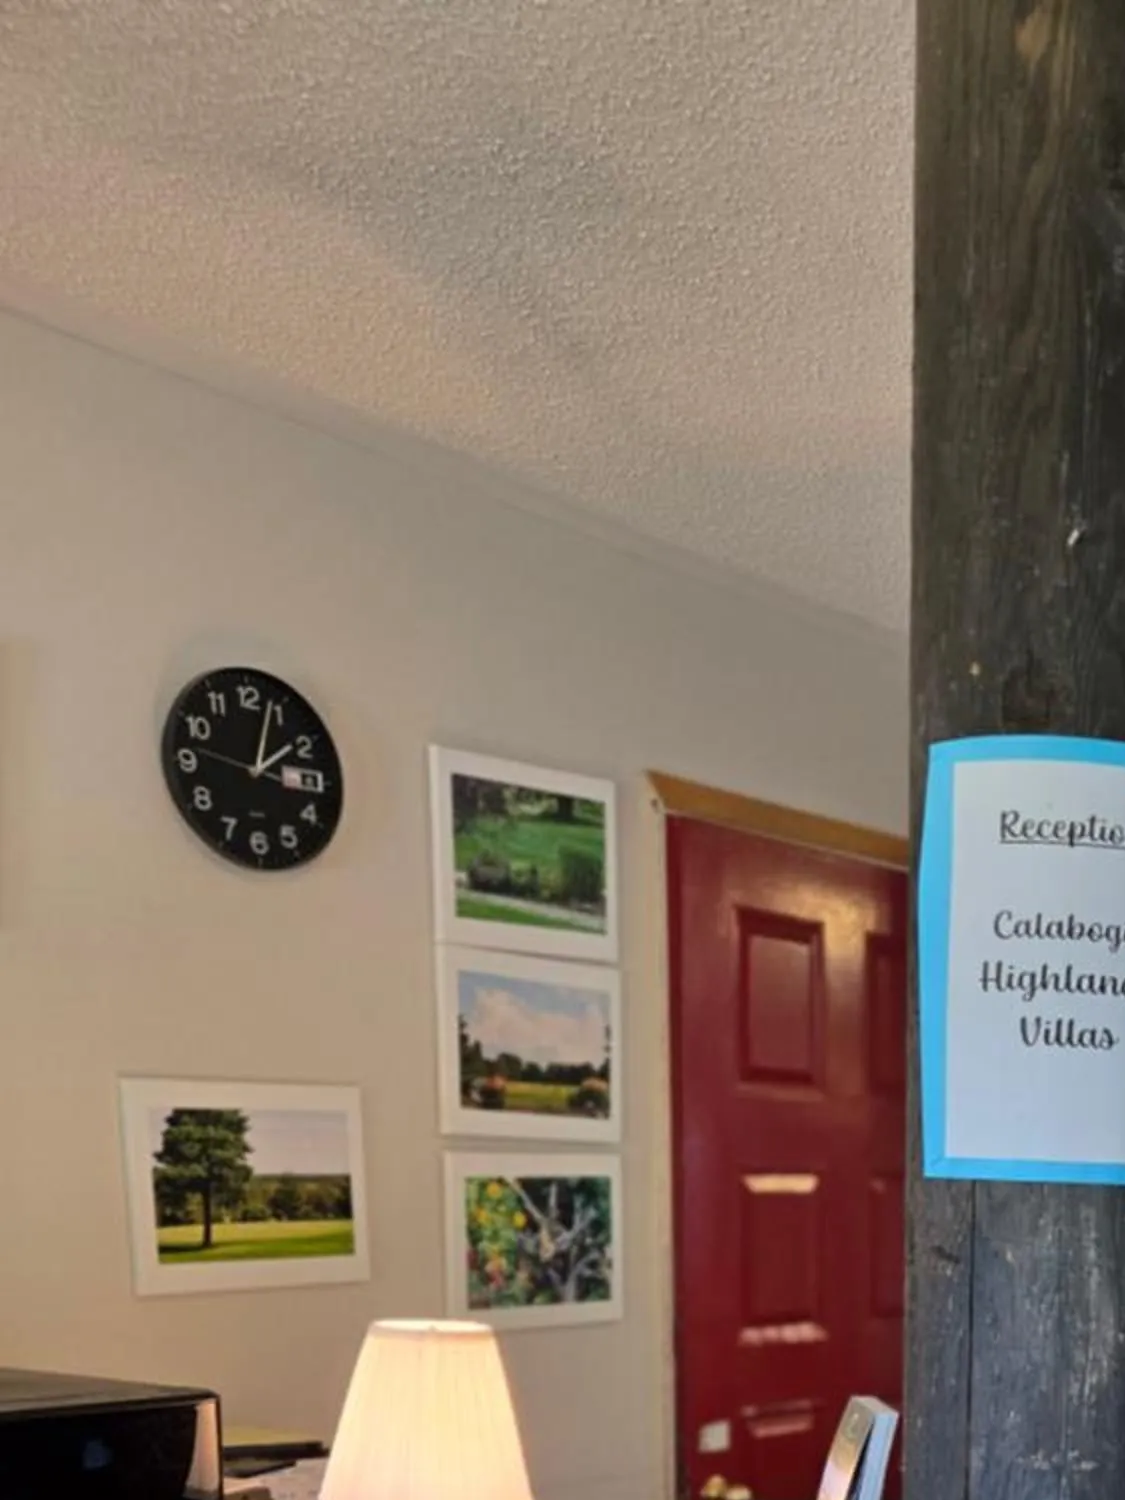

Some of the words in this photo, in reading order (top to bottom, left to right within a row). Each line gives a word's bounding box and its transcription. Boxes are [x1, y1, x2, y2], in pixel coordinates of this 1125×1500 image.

[208, 691, 225, 716] 11
[236, 686, 260, 710] 12
[274, 704, 283, 726] 1
[186, 716, 210, 740] 10
[295, 735, 312, 758] 2
[178, 748, 197, 772] 9
[193, 786, 212, 810] 8
[300, 804, 317, 825] 4
[221, 816, 237, 840] 7
[280, 825, 297, 848] 5
[249, 831, 269, 855] 6
[1019, 1016, 1119, 1051] Villas
